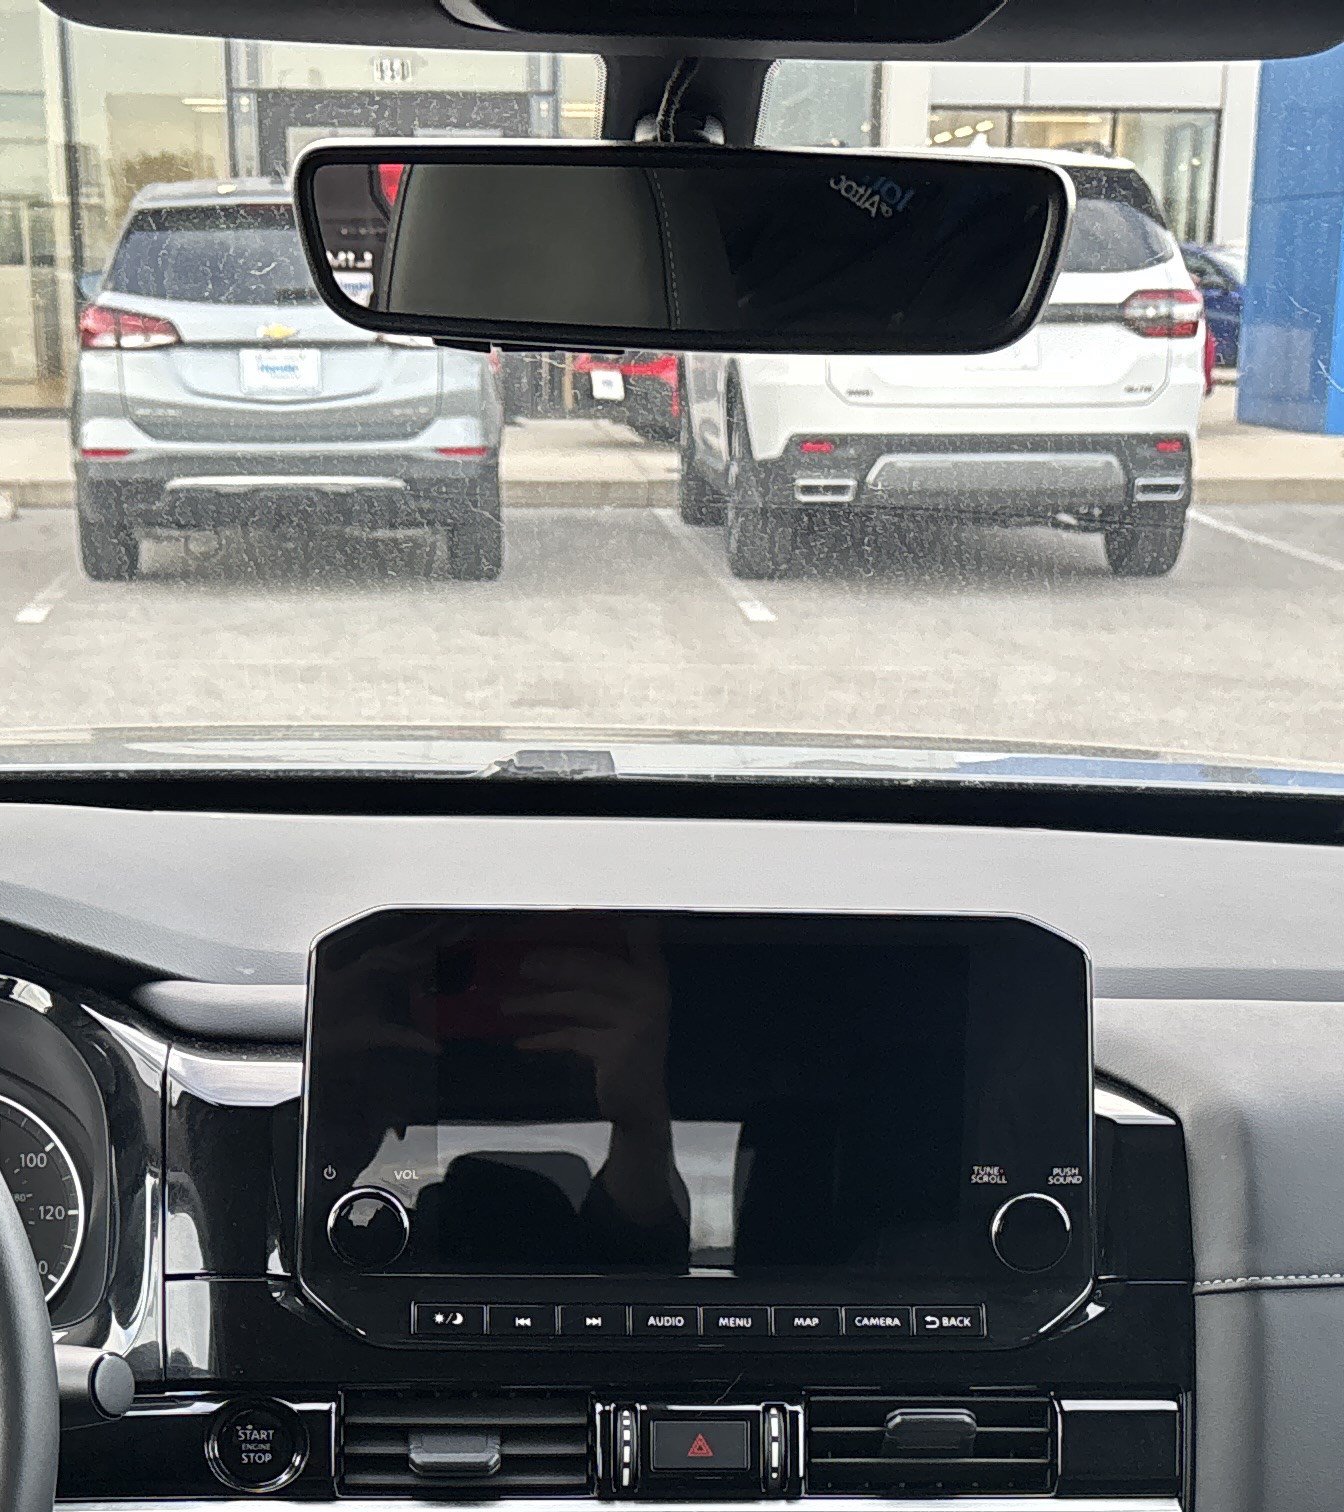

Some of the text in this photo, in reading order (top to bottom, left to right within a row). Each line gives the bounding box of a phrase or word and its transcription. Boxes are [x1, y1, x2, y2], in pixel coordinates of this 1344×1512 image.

[19, 1152, 48, 1168] 100
[393, 1169, 419, 1180] VOL
[1052, 1166, 1080, 1176] PUSH
[970, 1175, 1008, 1184] SCROLL
[1047, 1175, 1083, 1185] SOUND
[38, 1205, 66, 1221] 120
[647, 1315, 685, 1327] AUDIO
[717, 1316, 752, 1328] MENU
[793, 1316, 819, 1328] MAP
[854, 1316, 901, 1327] CAMERA
[941, 1315, 972, 1327] BACK
[237, 1429, 275, 1441] START
[241, 1442, 271, 1451] ENGINE
[240, 1452, 273, 1464] STOP
